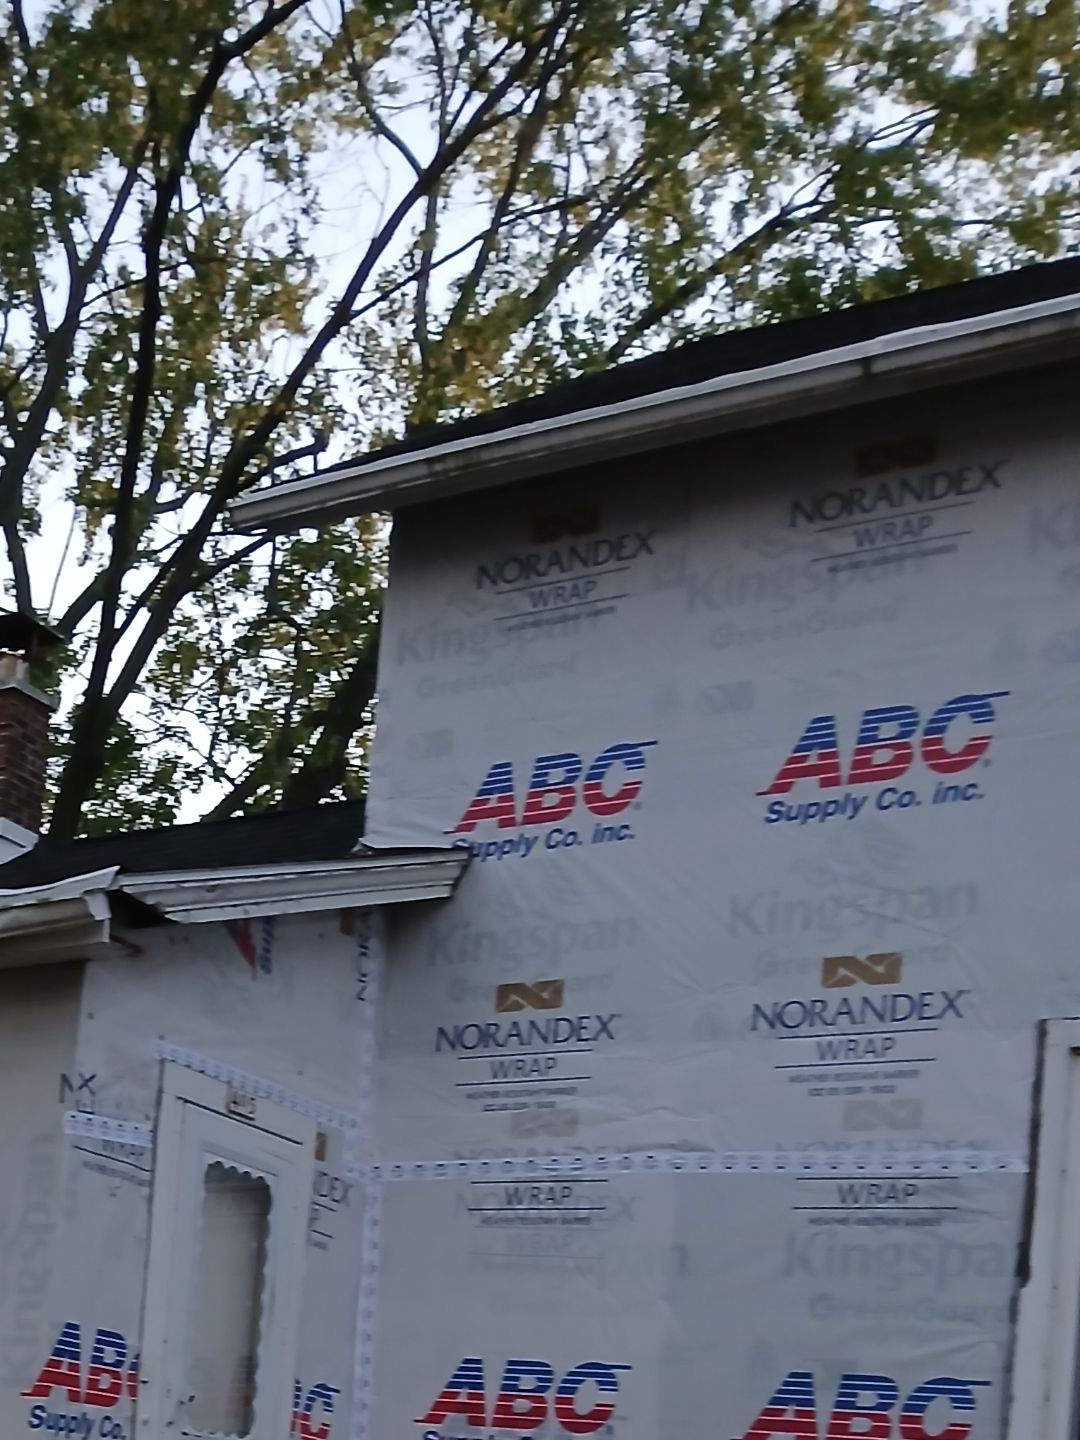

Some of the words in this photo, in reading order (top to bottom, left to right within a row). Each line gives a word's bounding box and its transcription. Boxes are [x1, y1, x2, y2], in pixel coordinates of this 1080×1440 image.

[788, 458, 1011, 528] NORANDEX
[852, 515, 934, 548] WRAP
[475, 529, 657, 590] NORANDEX
[526, 580, 599, 610] WRAP
[753, 690, 1013, 796] ABC
[443, 740, 658, 835] ABC
[762, 792, 867, 825] Supply
[874, 786, 924, 812] Co.
[545, 827, 583, 850] Co.
[749, 989, 974, 1031] NORANDEX
[435, 1013, 624, 1052] NORANDEX
[815, 1036, 897, 1061] WRAP
[488, 1057, 558, 1080] WRAP
[504, 1185, 573, 1206] WRAP
[837, 1183, 919, 1205] WRAP
[413, 1356, 633, 1435] ABC
[28, 1404, 94, 1440] Supply
[98, 1414, 127, 1440] Co.
